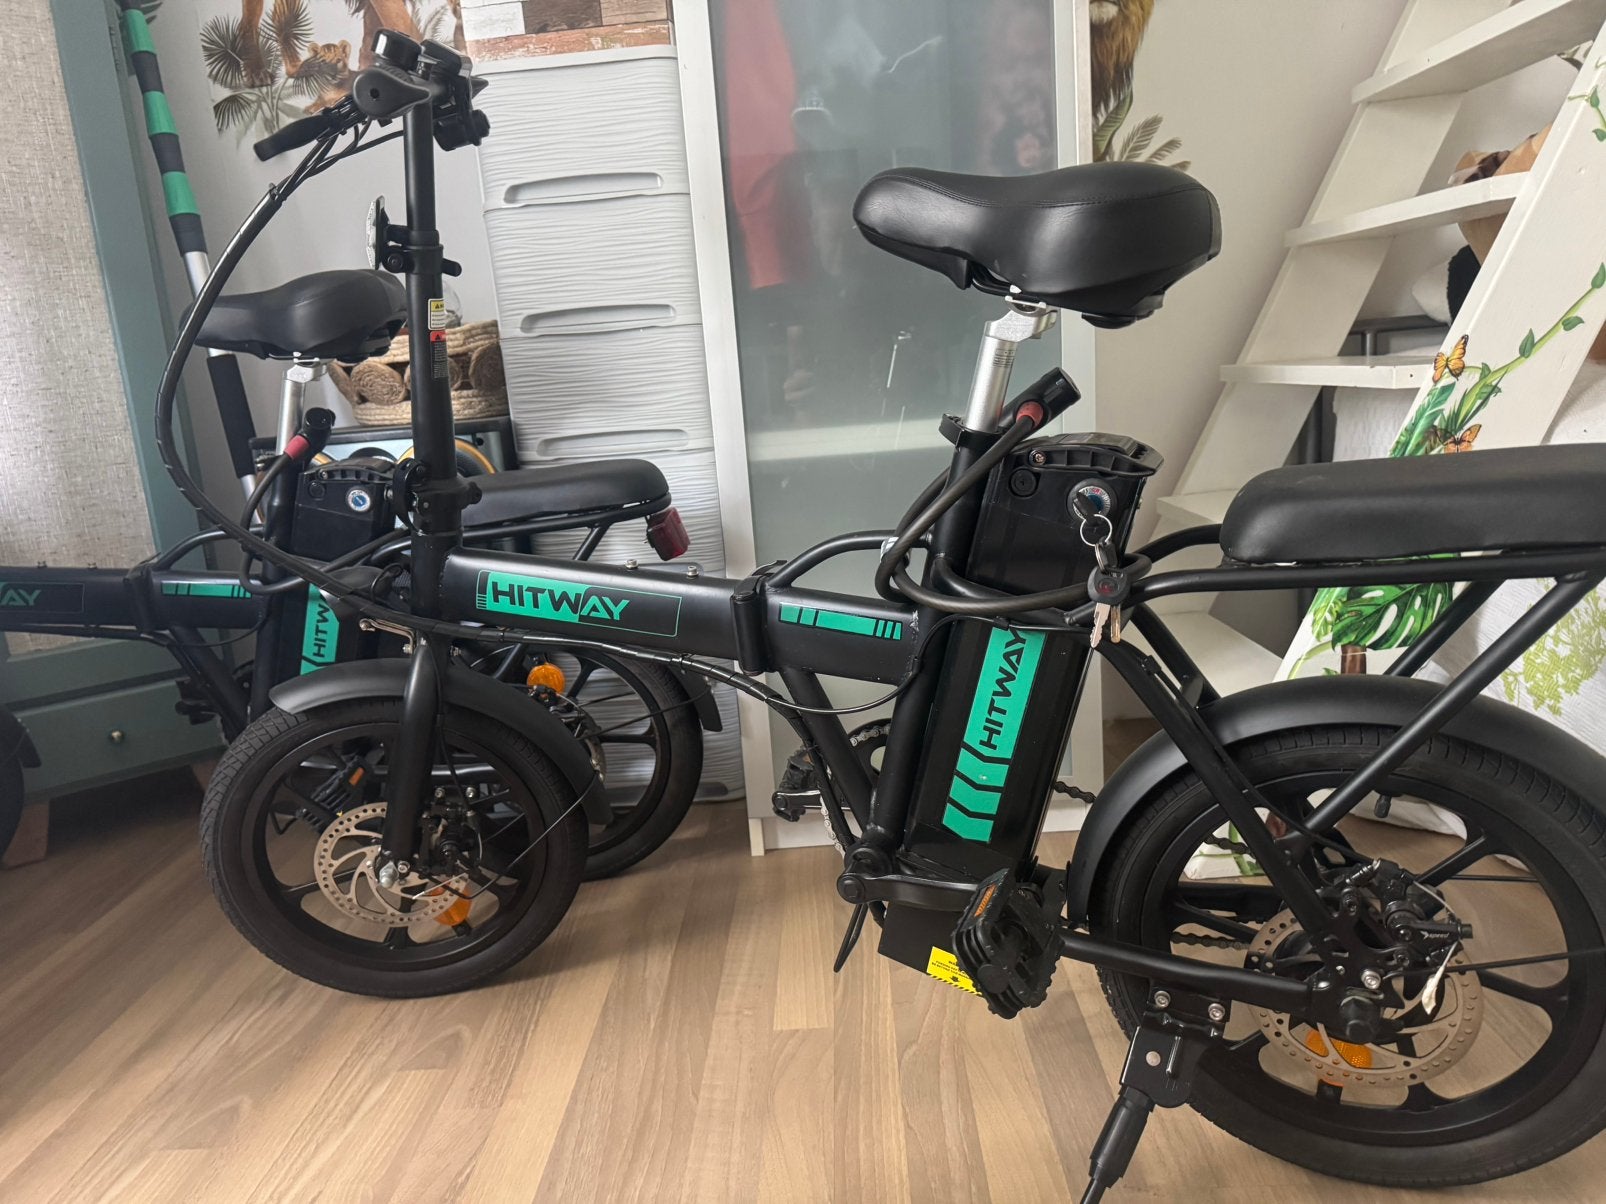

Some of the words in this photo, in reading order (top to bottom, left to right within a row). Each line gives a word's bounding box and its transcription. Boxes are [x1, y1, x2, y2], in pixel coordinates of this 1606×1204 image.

[491, 581, 630, 621] HITWAY
[312, 602, 331, 658] HITW
[979, 626, 1028, 751] HITWAY
